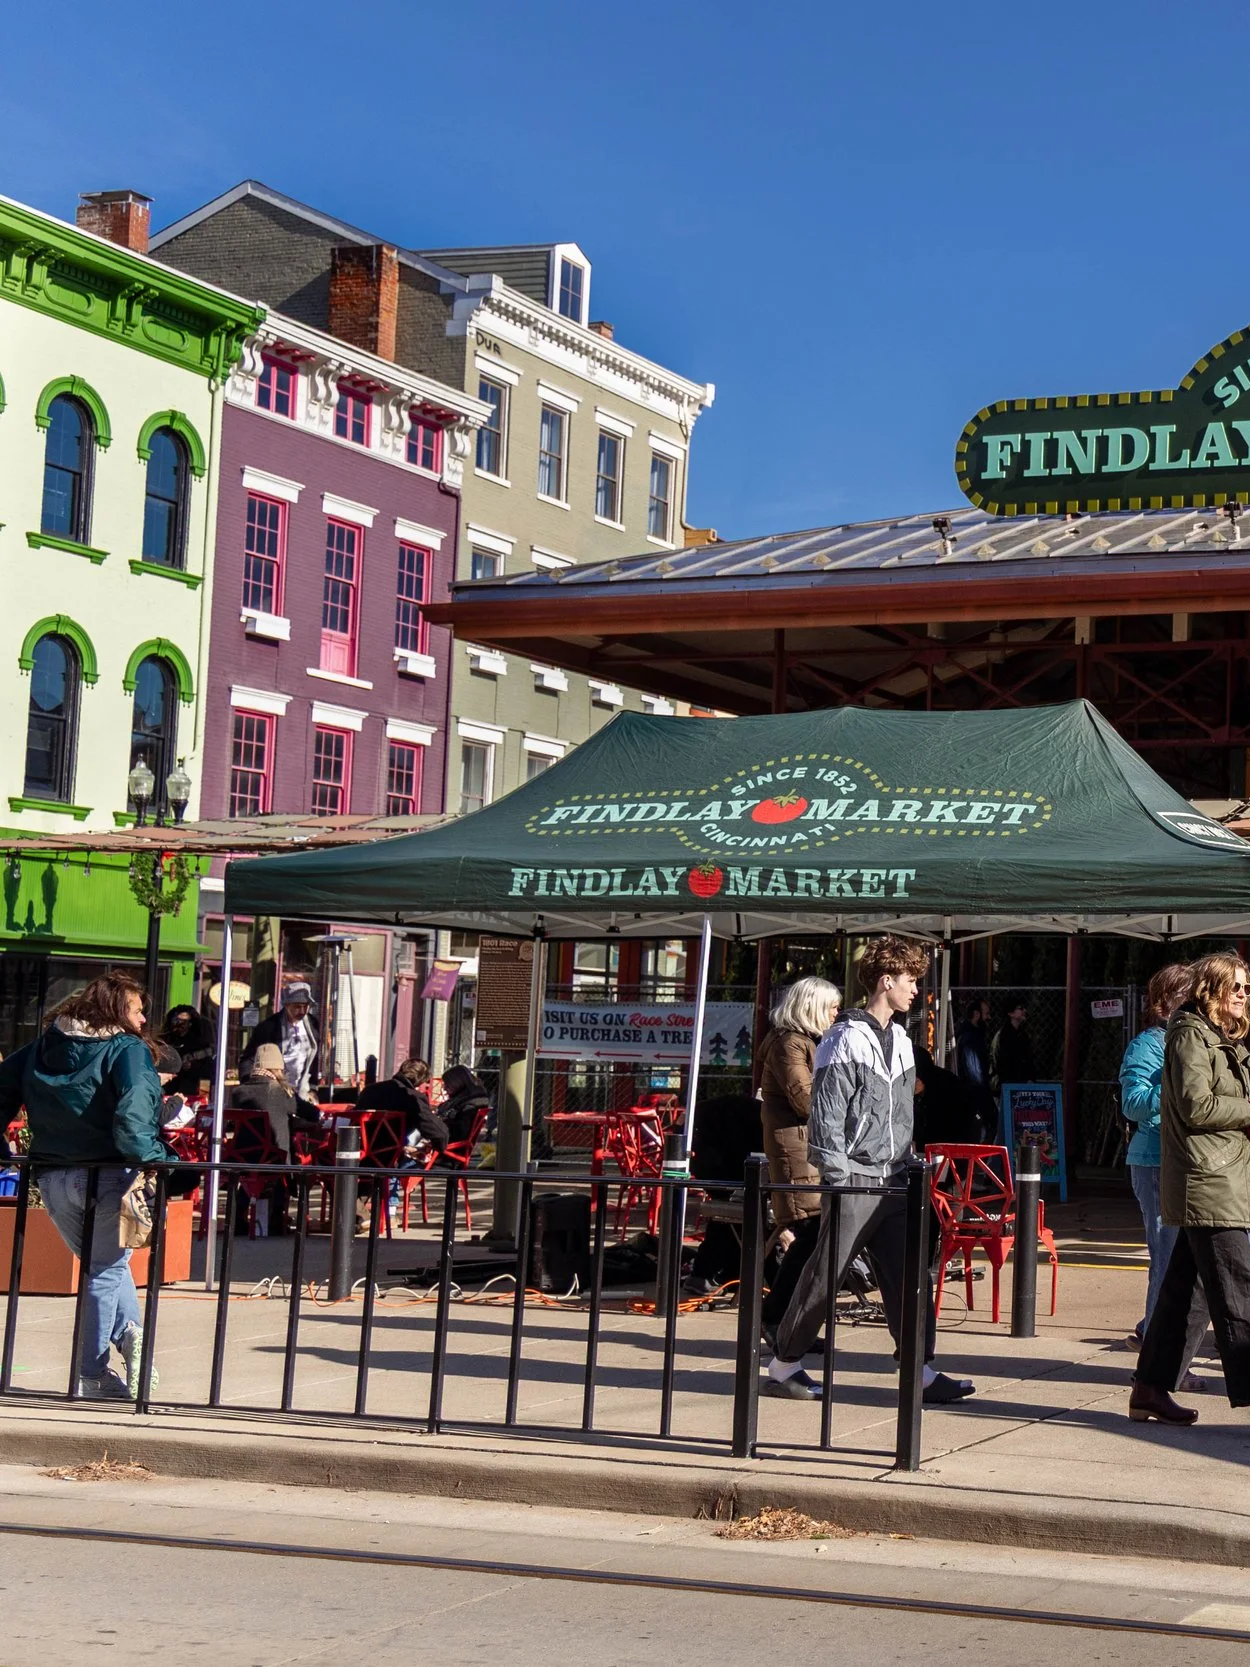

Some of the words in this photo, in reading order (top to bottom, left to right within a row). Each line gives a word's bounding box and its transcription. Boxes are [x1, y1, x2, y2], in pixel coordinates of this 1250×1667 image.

[730, 766, 807, 797] SINCE
[814, 767, 858, 796] 1852
[541, 798, 761, 825] FINDLAY
[799, 798, 1038, 825] MARKET
[699, 822, 839, 848] CINCINNATI
[508, 868, 688, 898] FINDLAY
[725, 868, 916, 899] MARKET
[544, 1010, 575, 1025] ISIT
[579, 1012, 599, 1025] US
[602, 1013, 627, 1026] ON
[629, 1012, 663, 1028] Race
[666, 1013, 705, 1028] Stre
[544, 1026, 555, 1040] O
[558, 1027, 642, 1043] PURCHASE
[646, 1030, 657, 1043] A
[661, 1030, 693, 1044] TRE
